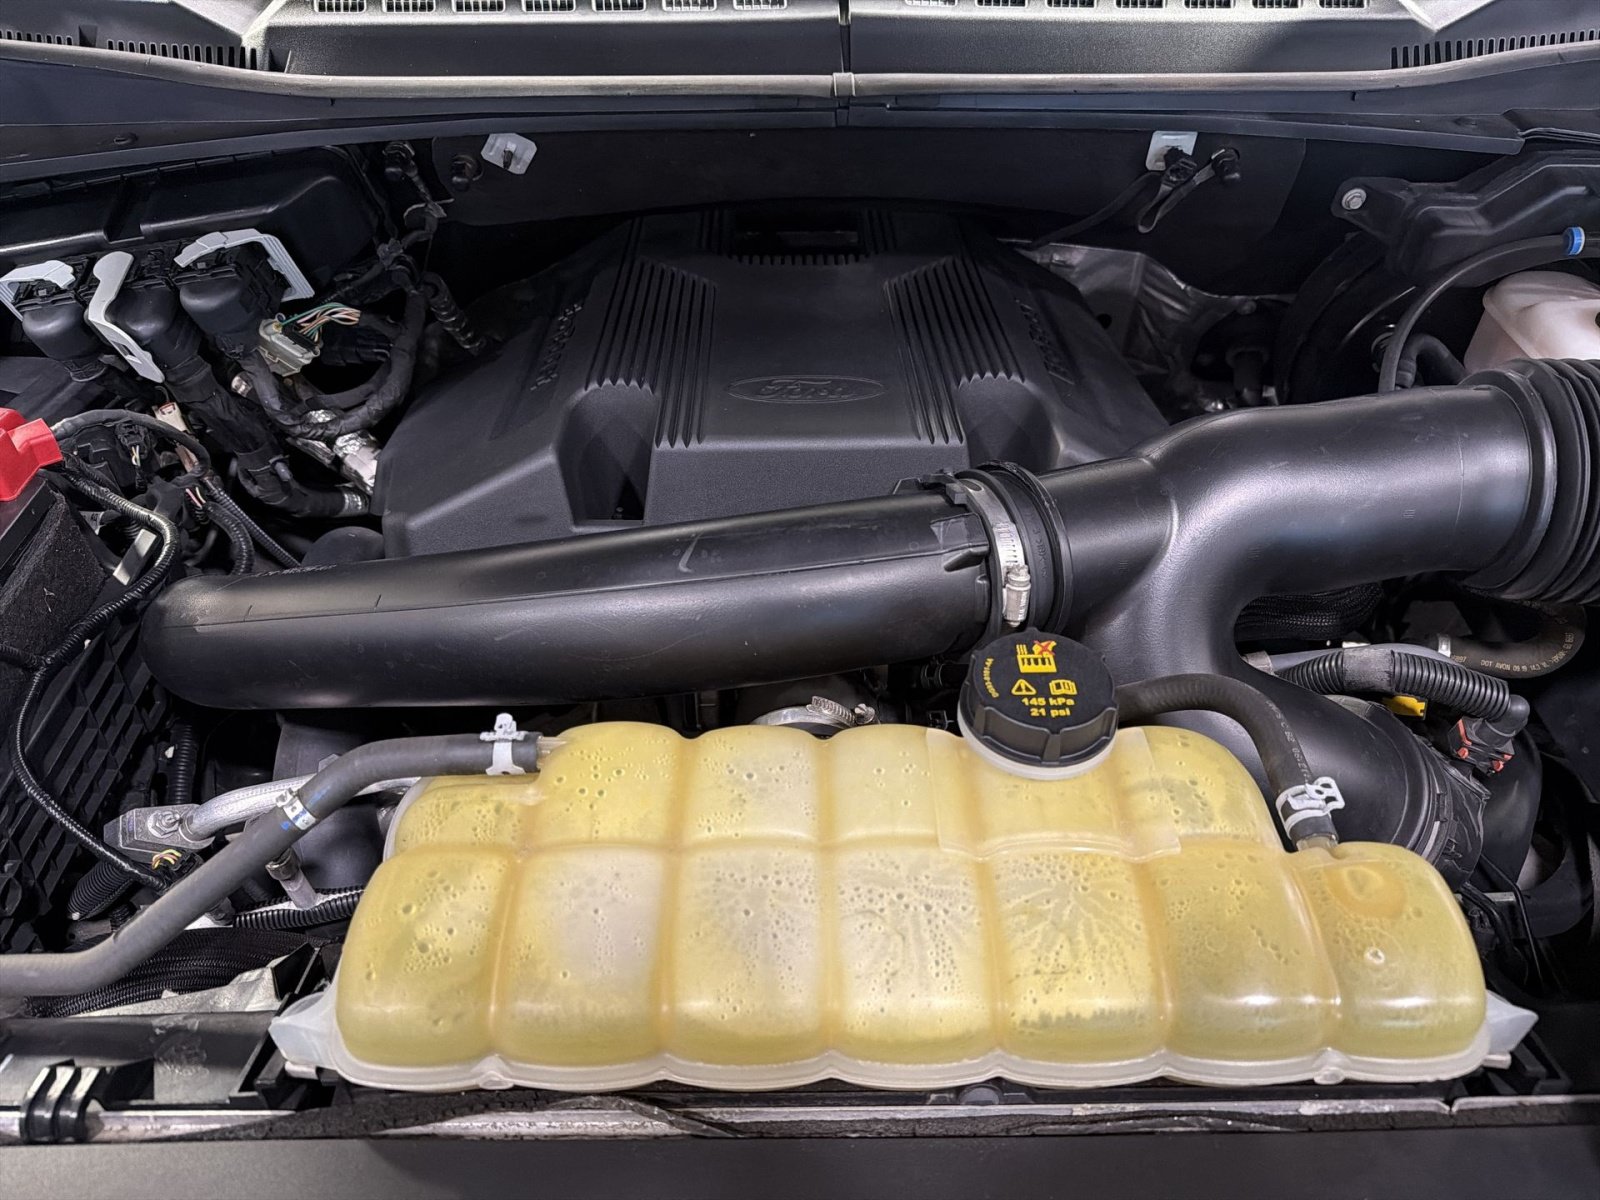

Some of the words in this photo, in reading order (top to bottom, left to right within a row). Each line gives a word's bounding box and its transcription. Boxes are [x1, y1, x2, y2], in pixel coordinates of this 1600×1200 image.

[1021, 697, 1047, 706] 145
[1048, 697, 1075, 706] kPa
[1029, 708, 1046, 717] 21
[1050, 707, 1071, 718] psi
